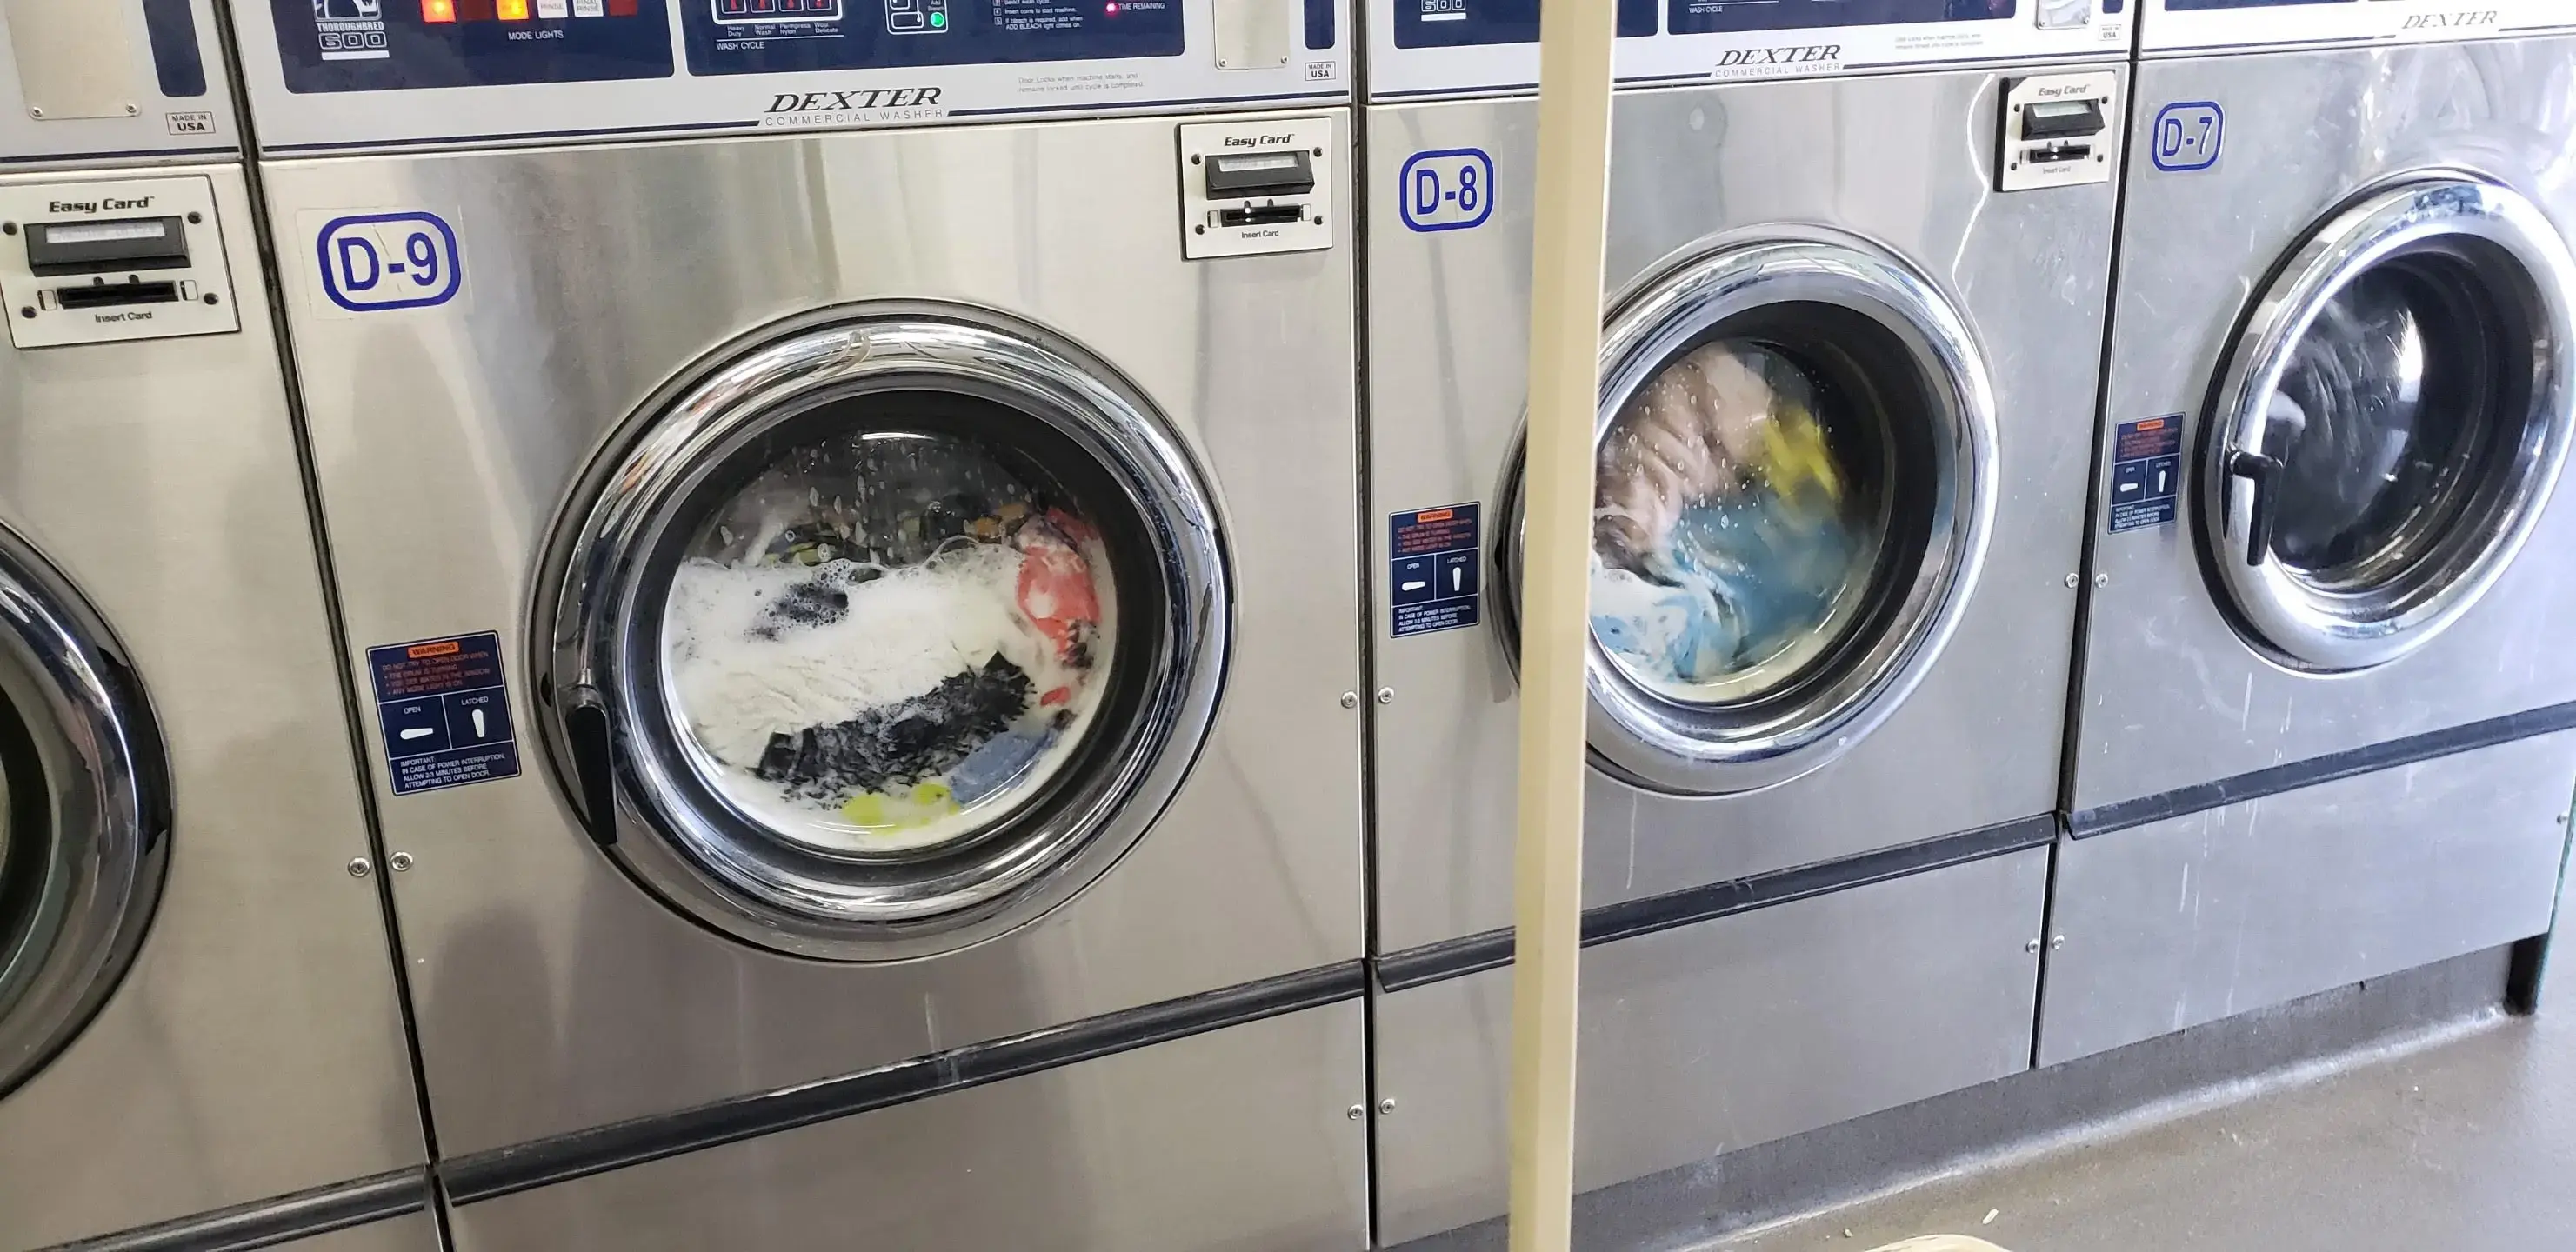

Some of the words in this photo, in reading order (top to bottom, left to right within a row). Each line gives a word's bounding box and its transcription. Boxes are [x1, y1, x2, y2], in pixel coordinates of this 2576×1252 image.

[2401, 10, 2498, 30] DEXTER
[316, 22, 384, 32] THOROUGHBRED
[318, 31, 388, 50] 600
[508, 31, 533, 40] MODE
[535, 30, 564, 39] LIGHTS
[740, 41, 765, 50] CYCLE
[1715, 44, 1841, 67] DEXTER
[1311, 70, 1330, 78] USA
[1715, 66, 1789, 78] COMMERCIAL
[1795, 63, 1840, 73] WASHER
[2038, 88, 2062, 97] Easy
[763, 87, 942, 113] DEXTER
[765, 112, 871, 127] COMMERCIAL
[879, 109, 944, 121] WASHER
[177, 122, 206, 131] USA
[1224, 136, 1257, 147] Easy
[2162, 117, 2213, 156] D-7
[1416, 165, 1478, 215] D-8
[49, 200, 97, 214] Easy
[1241, 230, 1261, 239] Insert
[1262, 230, 1279, 238] Card
[337, 232, 438, 291] D-9
[95, 312, 125, 323] Insert
[127, 311, 153, 321] Card
[412, 643, 456, 656] WARNING
[461, 696, 489, 706] LATCHED
[404, 706, 422, 715] OPEN
[404, 773, 424, 782] ALLOW
[436, 767, 462, 776] MINUTES
[464, 763, 487, 772] BEFORE
[410, 765, 426, 774] CASE
[437, 760, 460, 769] POWER
[404, 776, 442, 789] ATTEMPTING
